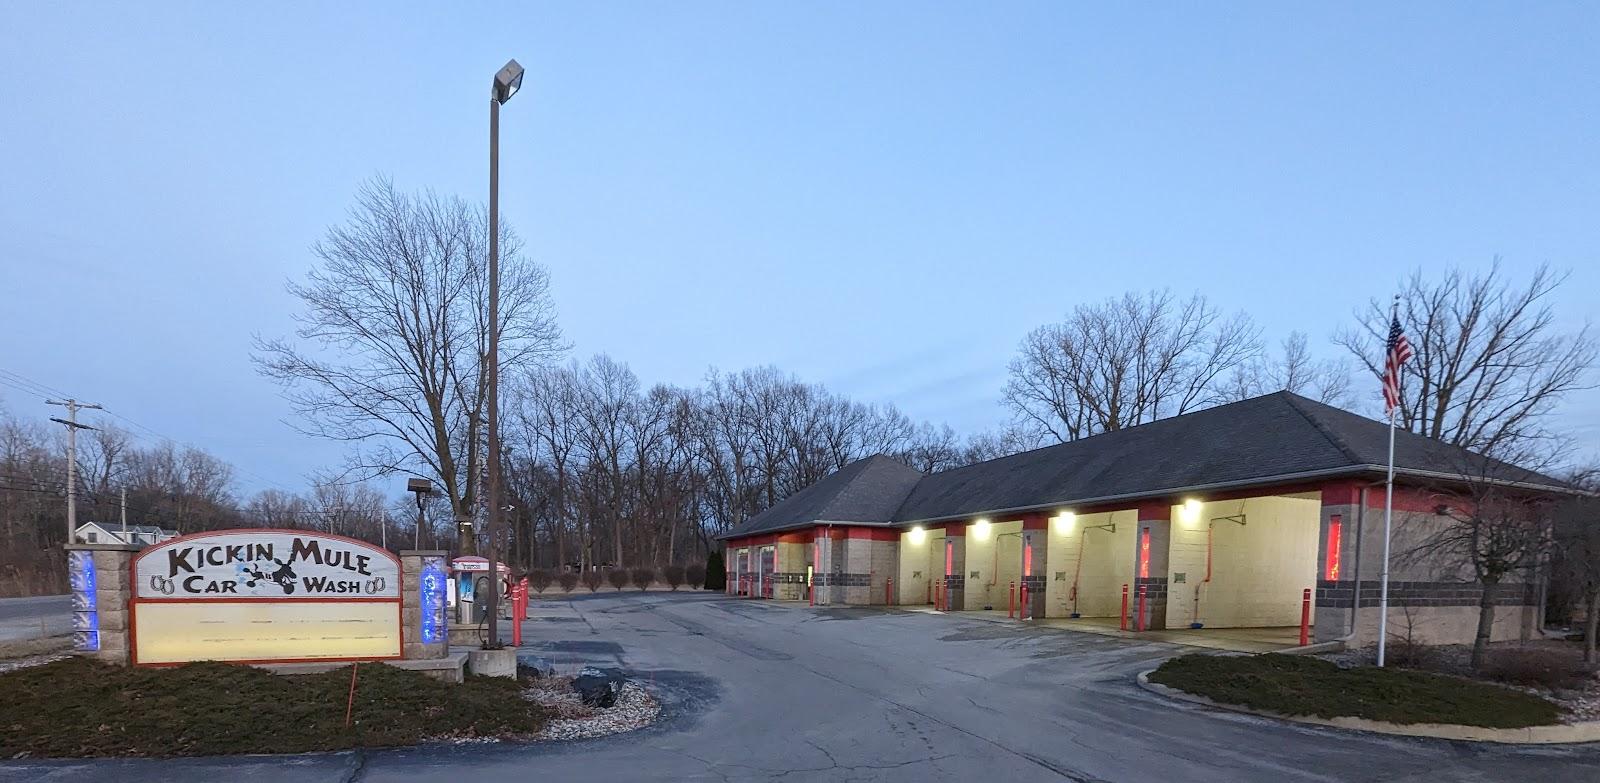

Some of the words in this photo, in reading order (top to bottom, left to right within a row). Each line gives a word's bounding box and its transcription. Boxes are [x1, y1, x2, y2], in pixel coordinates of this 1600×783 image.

[168, 543, 273, 577] KICKIN
[292, 538, 372, 576] MULE
[183, 575, 238, 594] CAR
[303, 576, 360, 594] WASH
